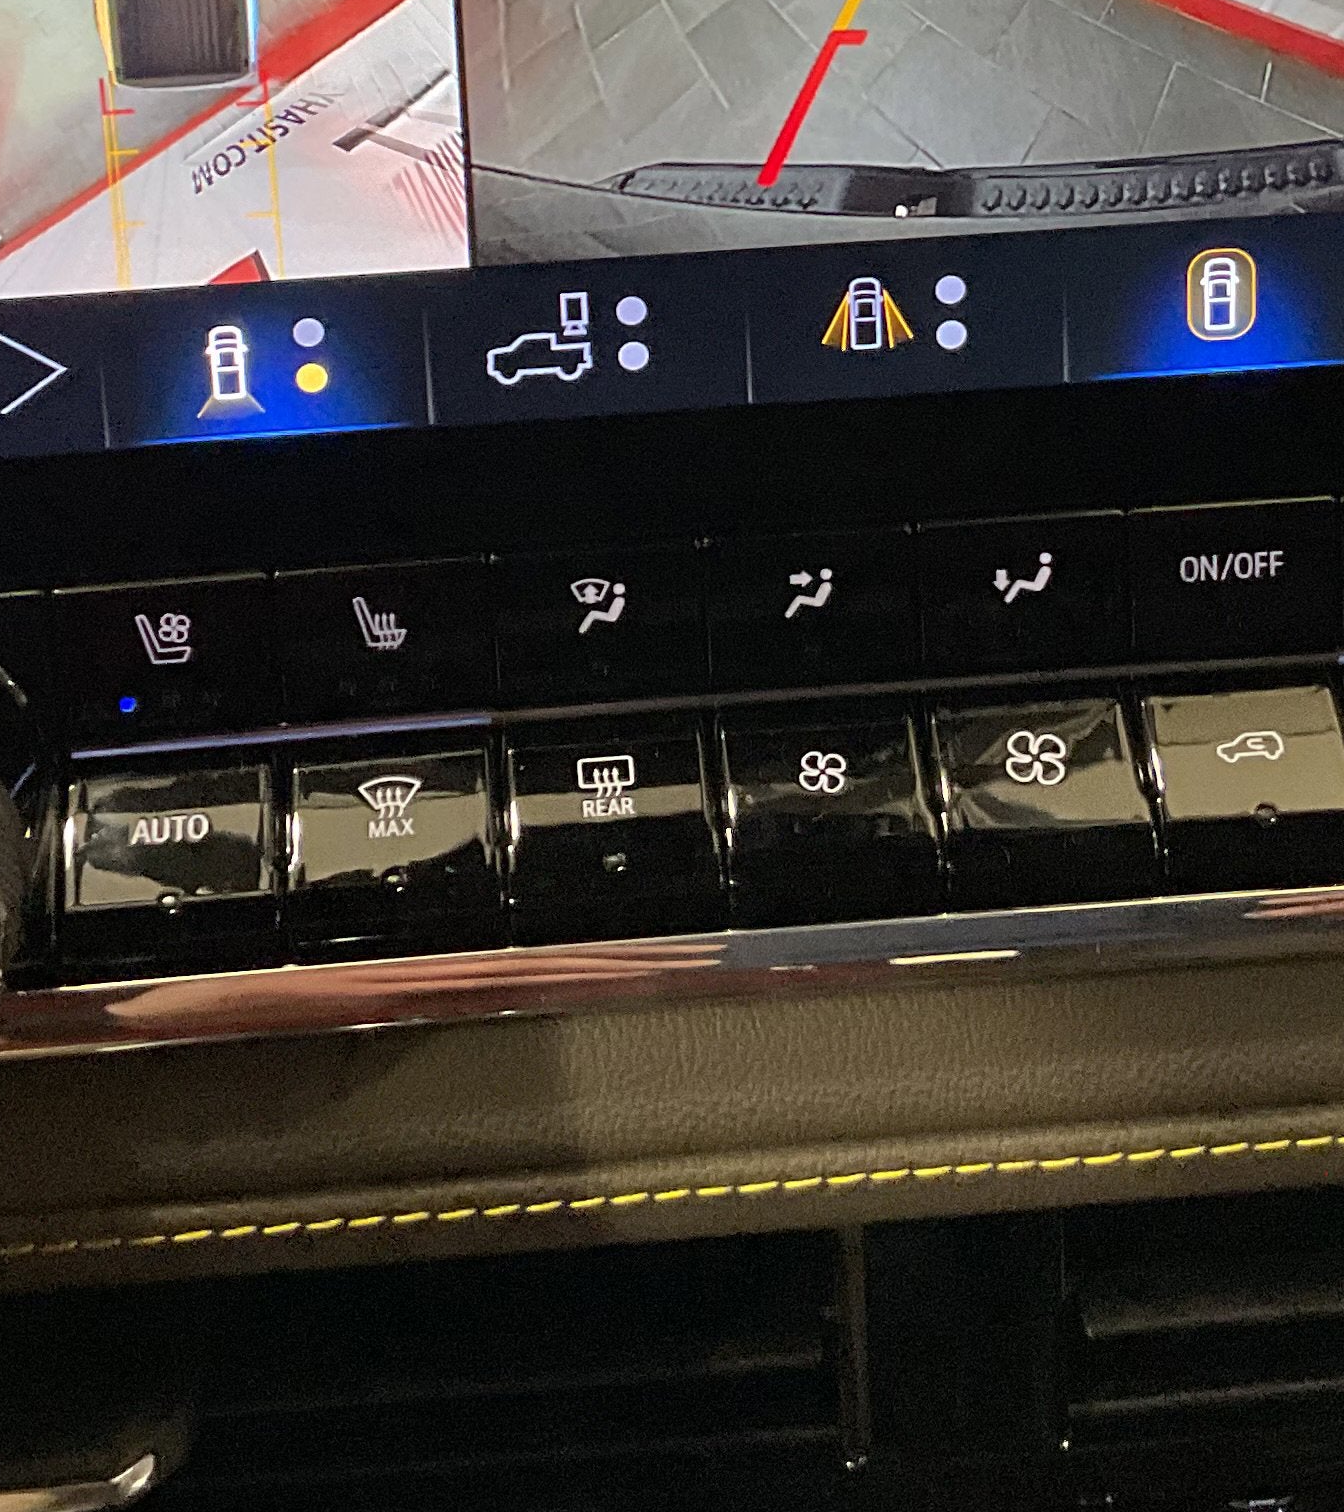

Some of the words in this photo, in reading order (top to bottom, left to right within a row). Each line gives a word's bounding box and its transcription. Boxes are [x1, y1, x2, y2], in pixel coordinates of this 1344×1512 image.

[1179, 550, 1285, 583] ON/OFF
[582, 796, 636, 819] REAR
[129, 813, 210, 846] AUTO
[367, 818, 415, 839] MAX
